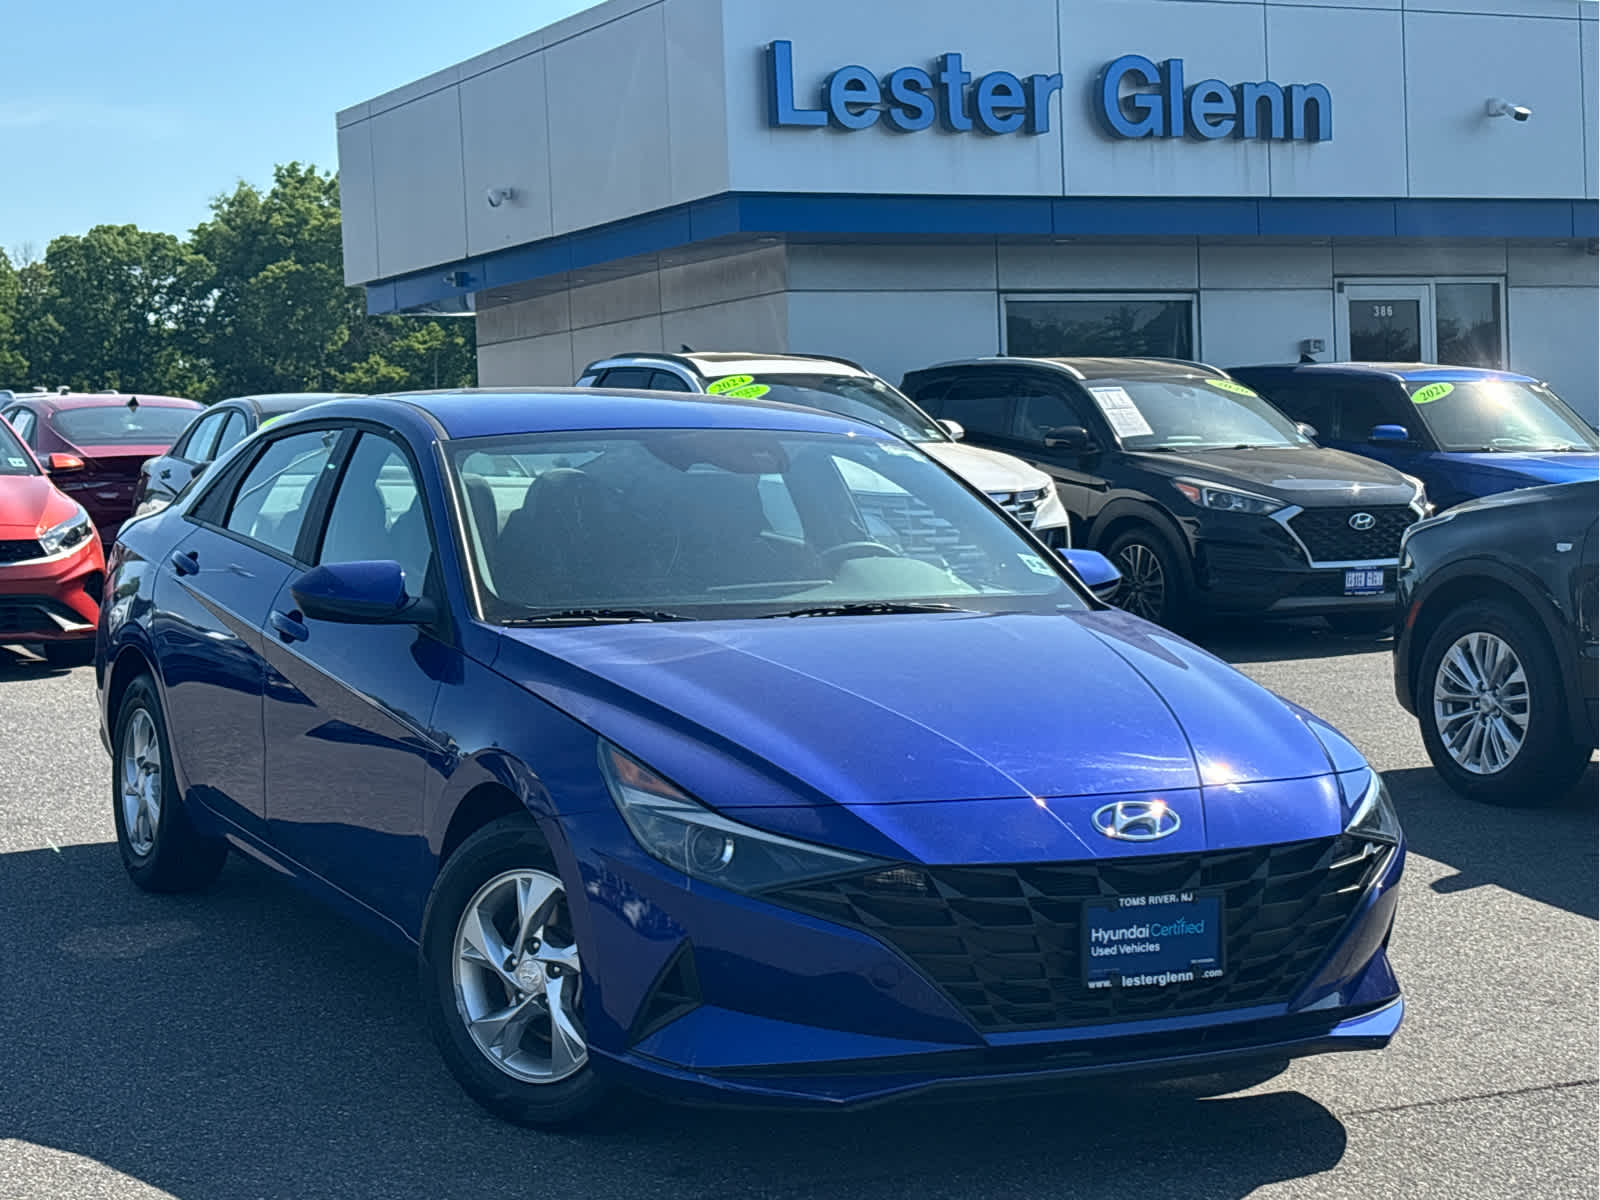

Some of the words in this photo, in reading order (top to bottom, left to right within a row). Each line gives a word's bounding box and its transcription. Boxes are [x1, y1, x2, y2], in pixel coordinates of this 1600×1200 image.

[768, 40, 1063, 135] Lester
[1101, 55, 1332, 141] Glenn
[1373, 305, 1393, 317] 386
[1420, 384, 1446, 401] 2021
[1119, 896, 1146, 907] TOMS
[1181, 892, 1193, 902] NJ
[1091, 924, 1150, 945] Hyundai
[1151, 917, 1205, 937] Certified
[1091, 944, 1118, 957] Used
[1119, 942, 1161, 954] Vehicles
[1121, 971, 1194, 988] lesterglenn
[1201, 969, 1223, 979] .com
